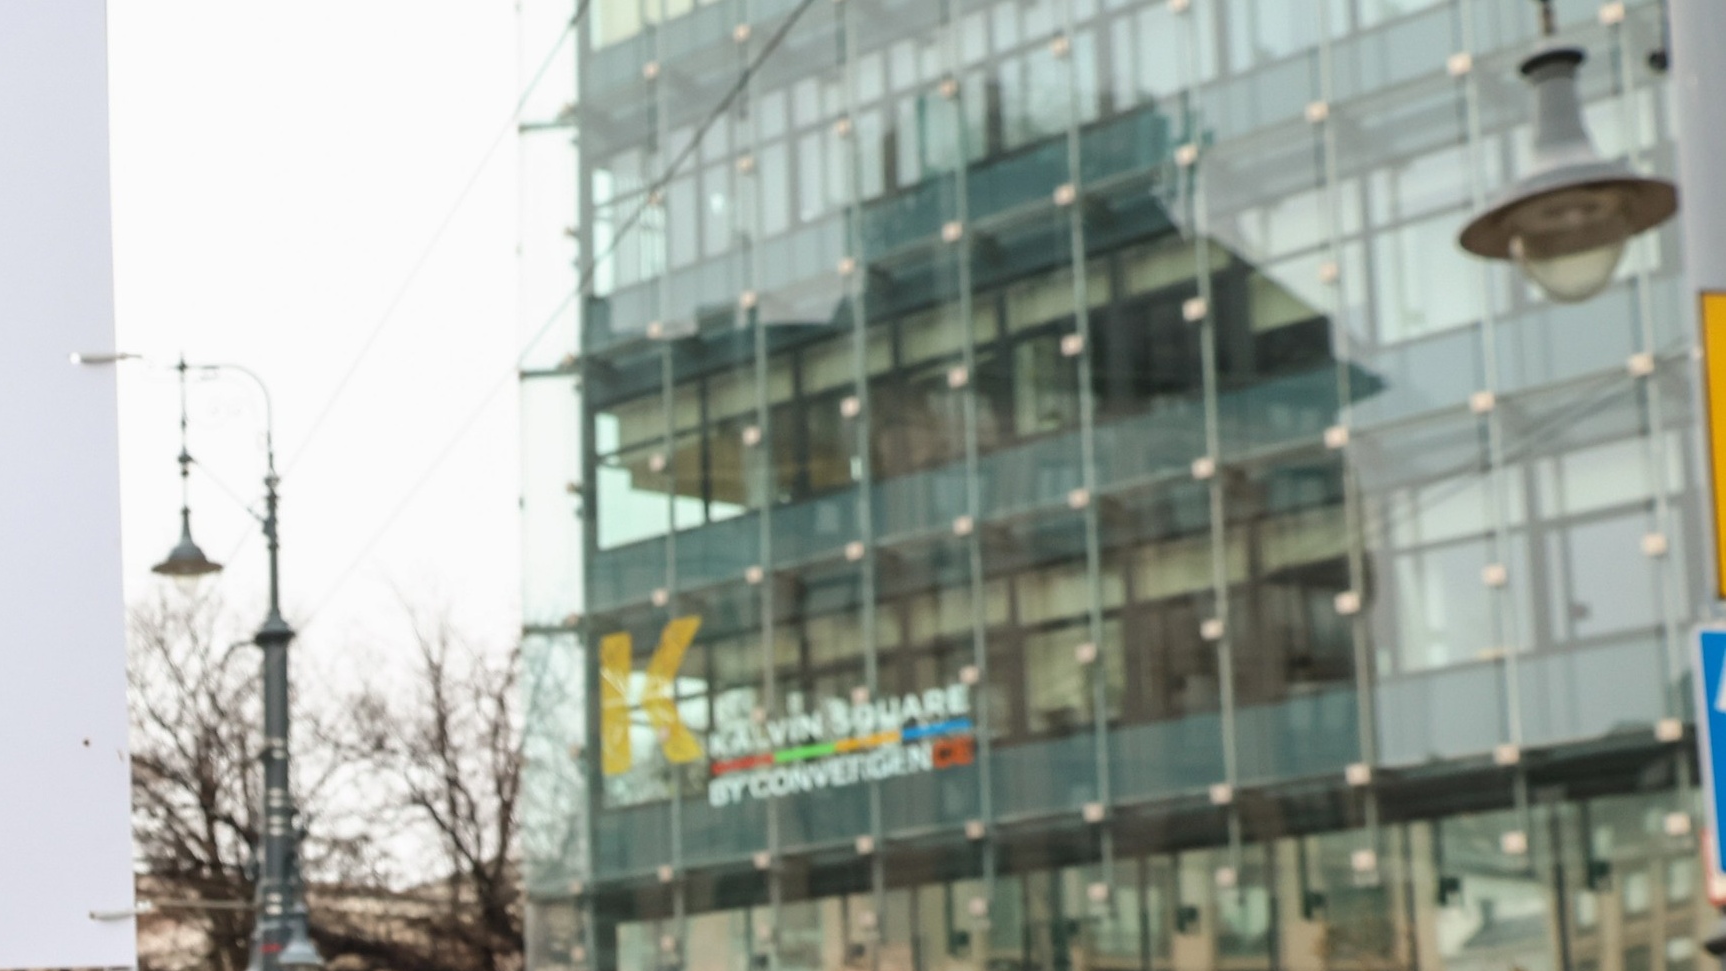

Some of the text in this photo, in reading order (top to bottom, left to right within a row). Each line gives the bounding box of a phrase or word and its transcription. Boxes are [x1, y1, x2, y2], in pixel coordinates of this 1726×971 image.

[599, 615, 704, 776] K
[828, 684, 970, 737] SQUARE
[708, 773, 747, 808] BY
